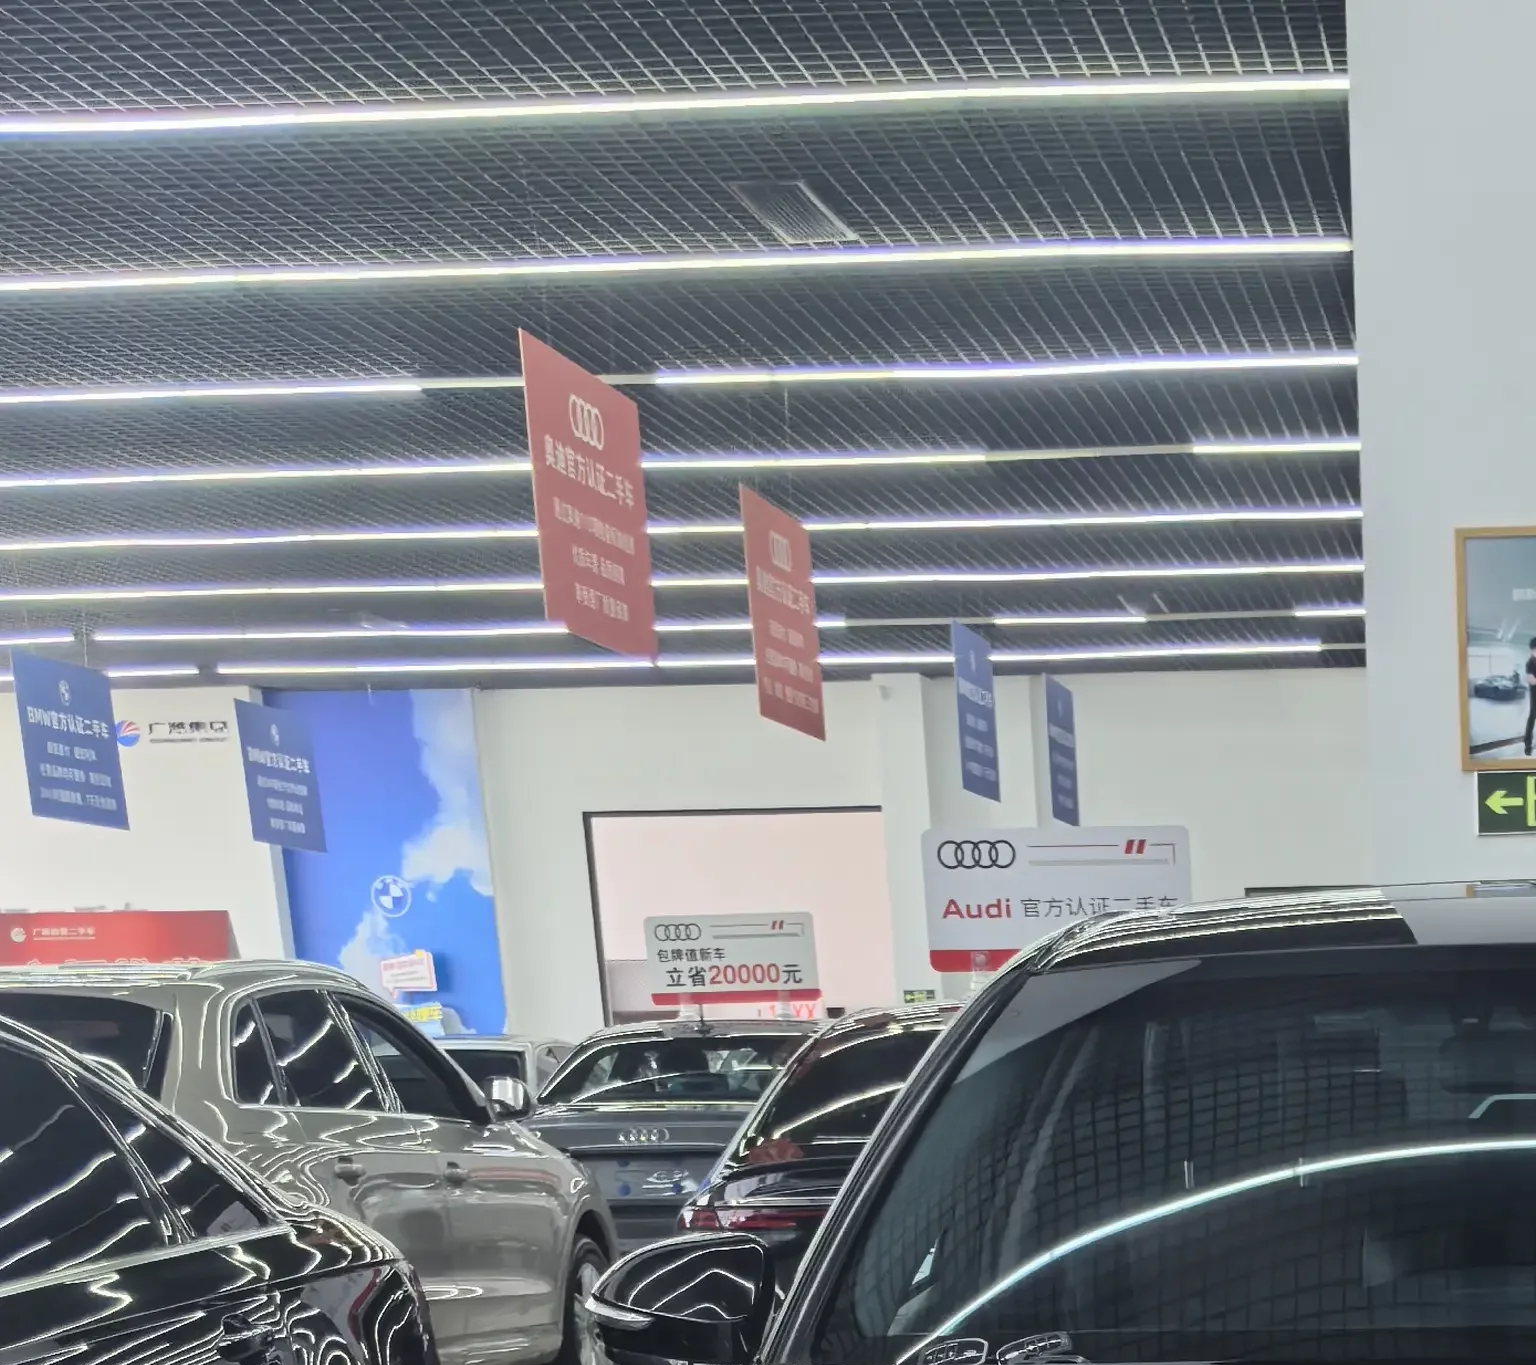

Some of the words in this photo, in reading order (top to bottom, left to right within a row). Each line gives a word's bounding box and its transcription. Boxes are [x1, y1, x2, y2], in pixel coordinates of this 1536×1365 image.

[942, 898, 1012, 919] Audi
[657, 948, 726, 963] 包牌值新车
[666, 963, 803, 988] 立省20000元
